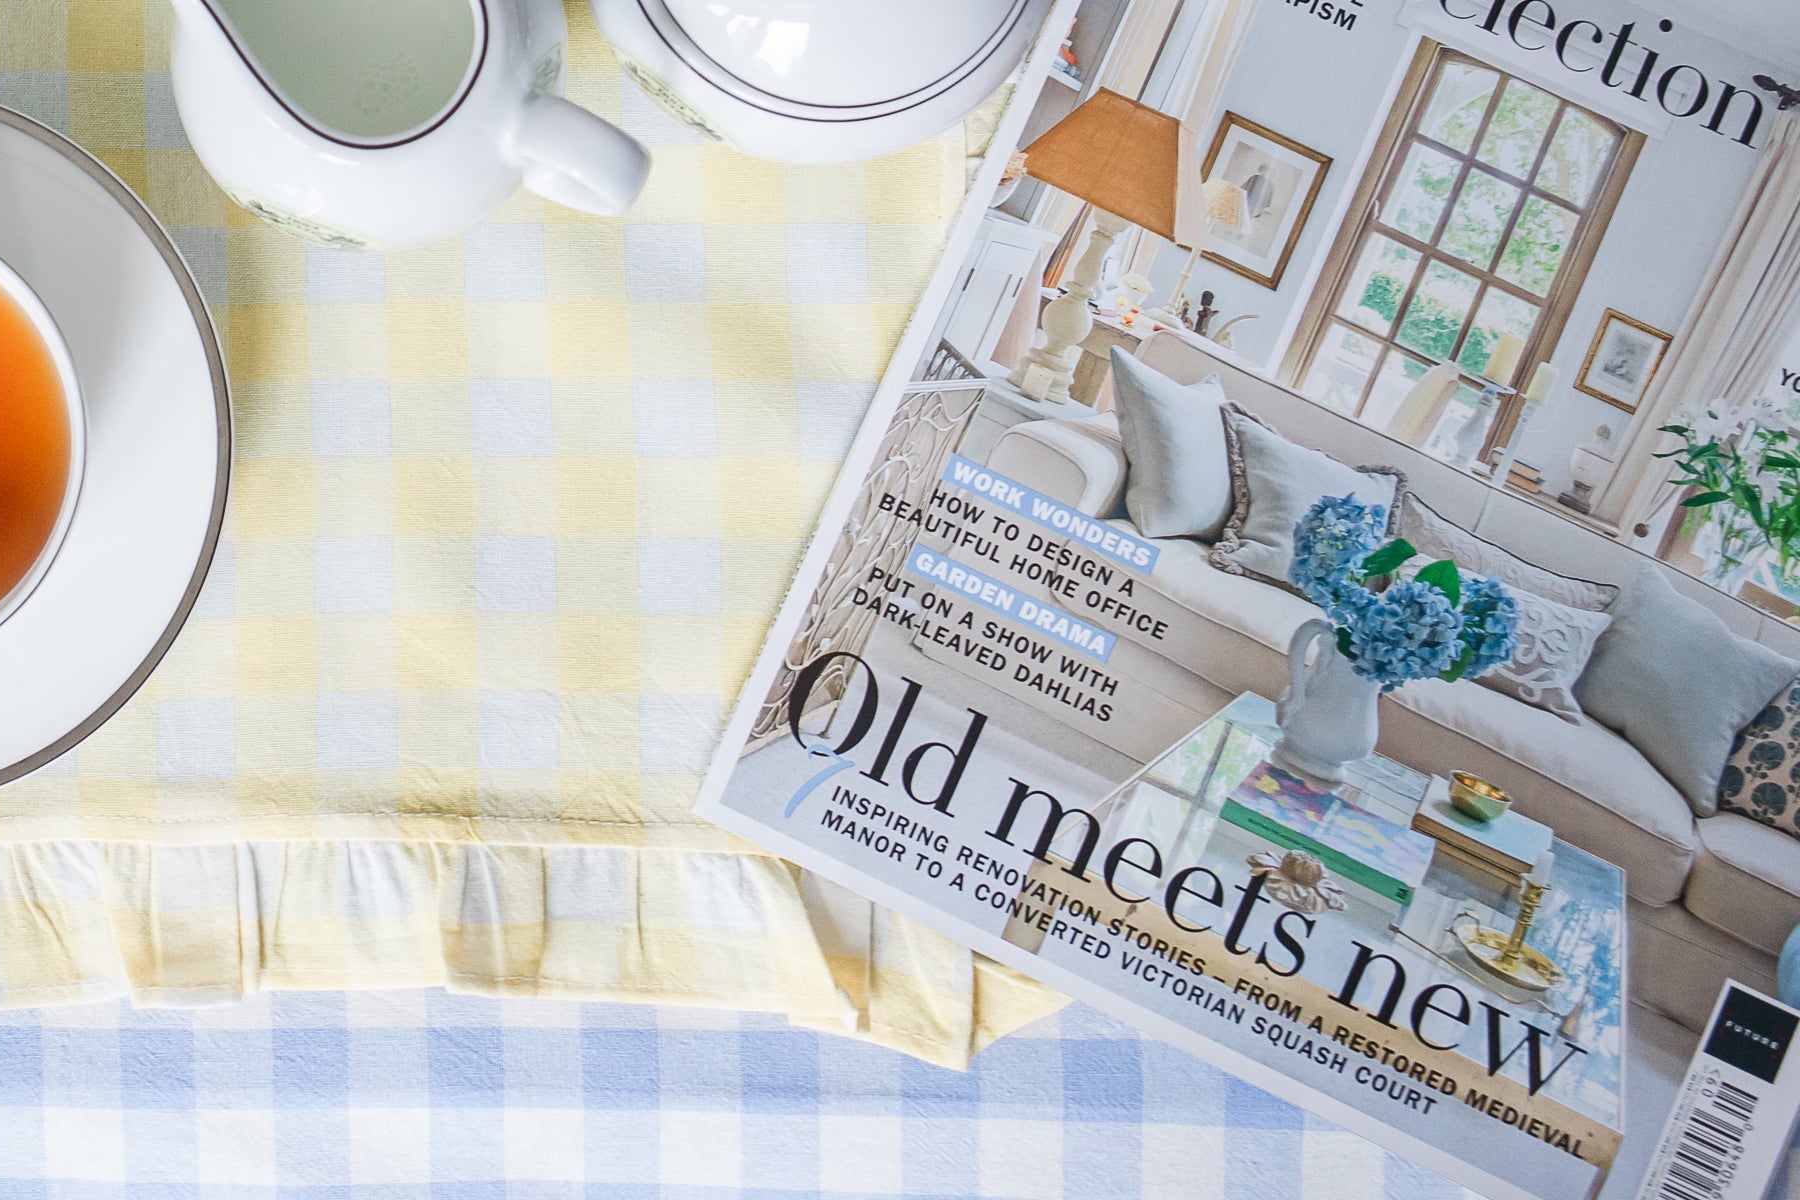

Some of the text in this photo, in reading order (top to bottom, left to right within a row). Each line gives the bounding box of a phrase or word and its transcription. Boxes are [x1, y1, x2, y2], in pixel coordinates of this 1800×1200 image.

[879, 493, 1168, 640] BEAUTIFUL HOME OFFICE
[929, 488, 1133, 597] HOW TO DESIGN A
[954, 462, 1150, 565] WORK WONDERS
[852, 587, 1113, 721] DARK-LEAVED DAHLIAS
[867, 565, 1118, 696] PUT ON A SHOW WITH
[916, 554, 1104, 654] GARDEN DRAMA
[784, 745, 855, 818] 7
[787, 649, 1590, 1097] Old meets new
[821, 810, 1437, 1114] MANOR TO A CONVERTED VICTORIAN SQUASH COURT
[832, 786, 948, 853] INSPIRING
[956, 846, 1101, 926] RENOVATION
[1107, 919, 1206, 976] STORIES
[1233, 978, 1302, 1022] FROM
[1308, 1016, 1323, 1034] A
[1332, 1025, 1457, 1095] RESTORED
[1464, 1088, 1590, 1159] MEDIEVAL
